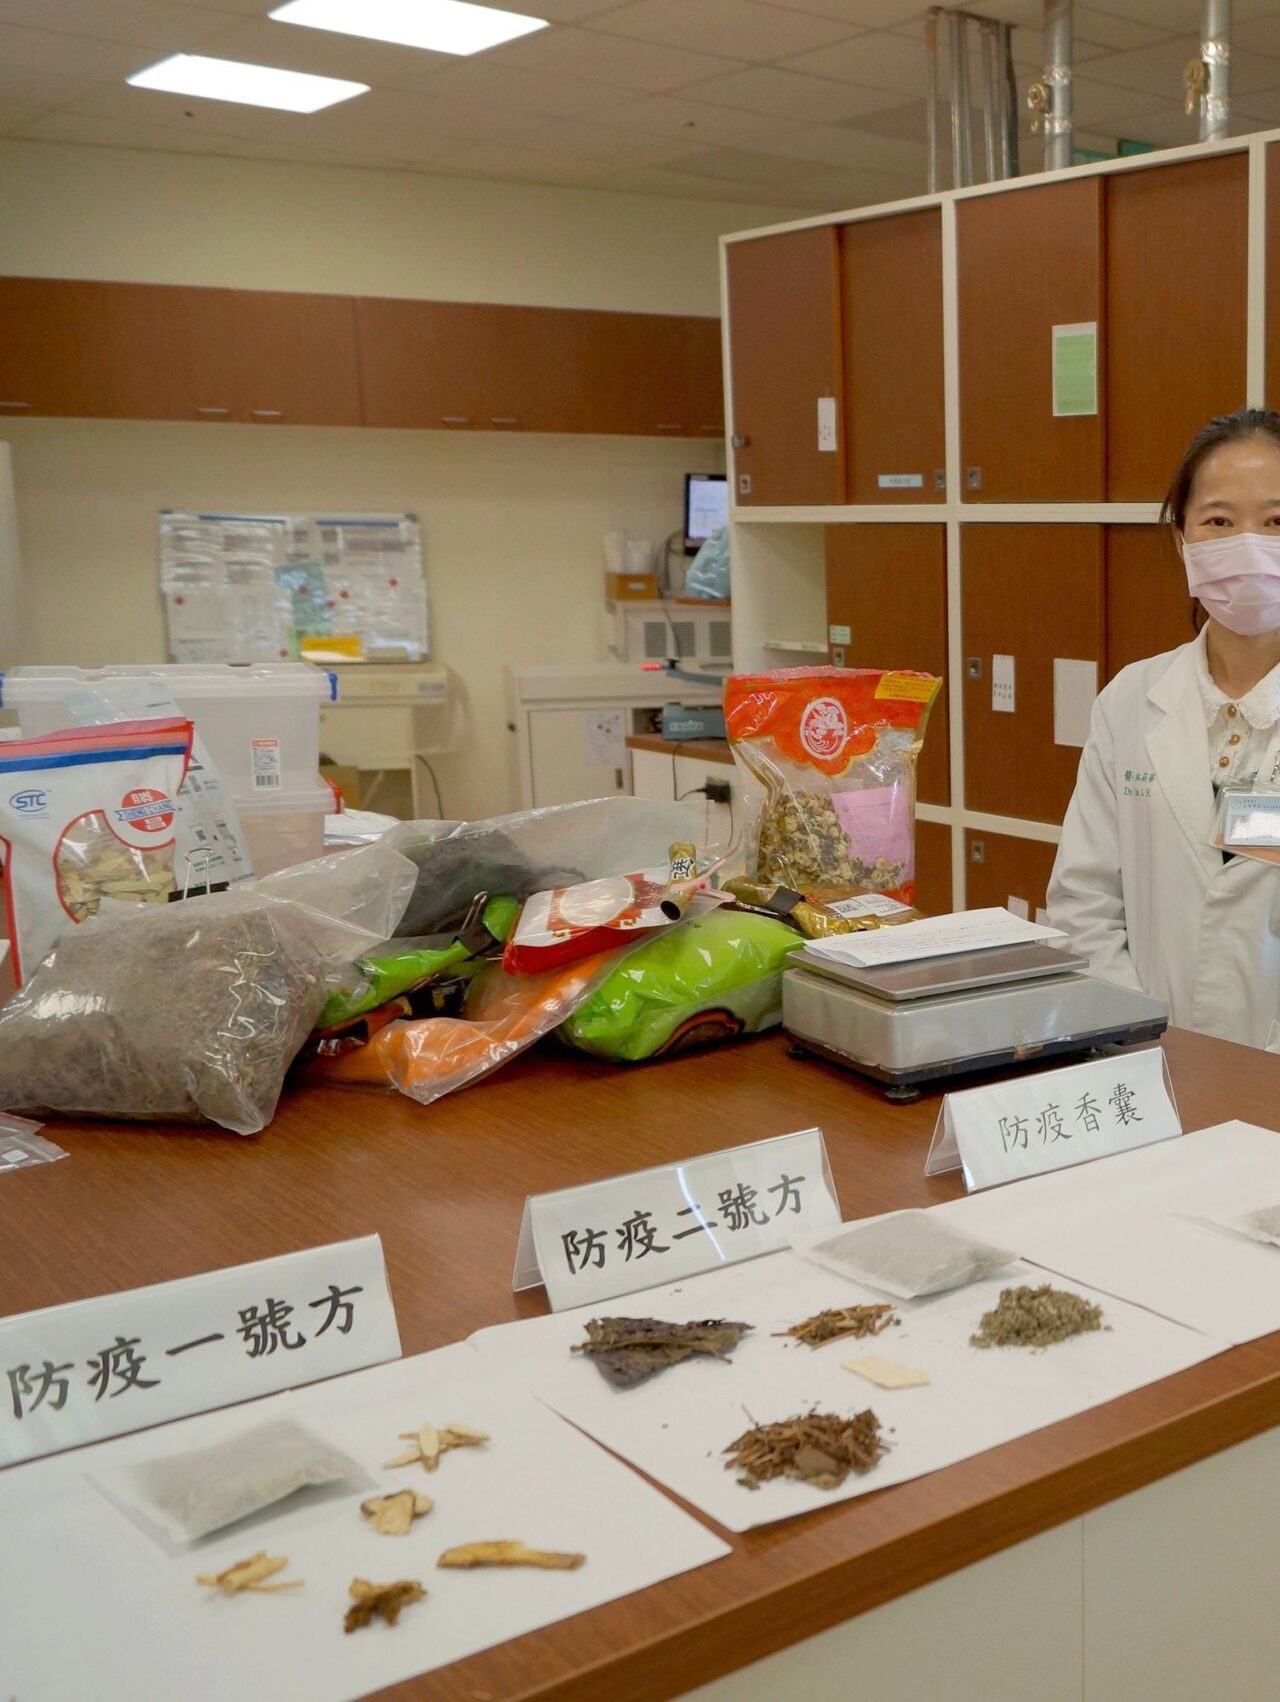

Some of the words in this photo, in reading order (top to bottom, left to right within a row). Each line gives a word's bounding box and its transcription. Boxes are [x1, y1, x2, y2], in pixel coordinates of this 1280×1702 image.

[997, 1082, 1144, 1153] 防疫香囊
[561, 1173, 806, 1275] 防疫二號方
[6, 1284, 364, 1419] 防疫一號方
